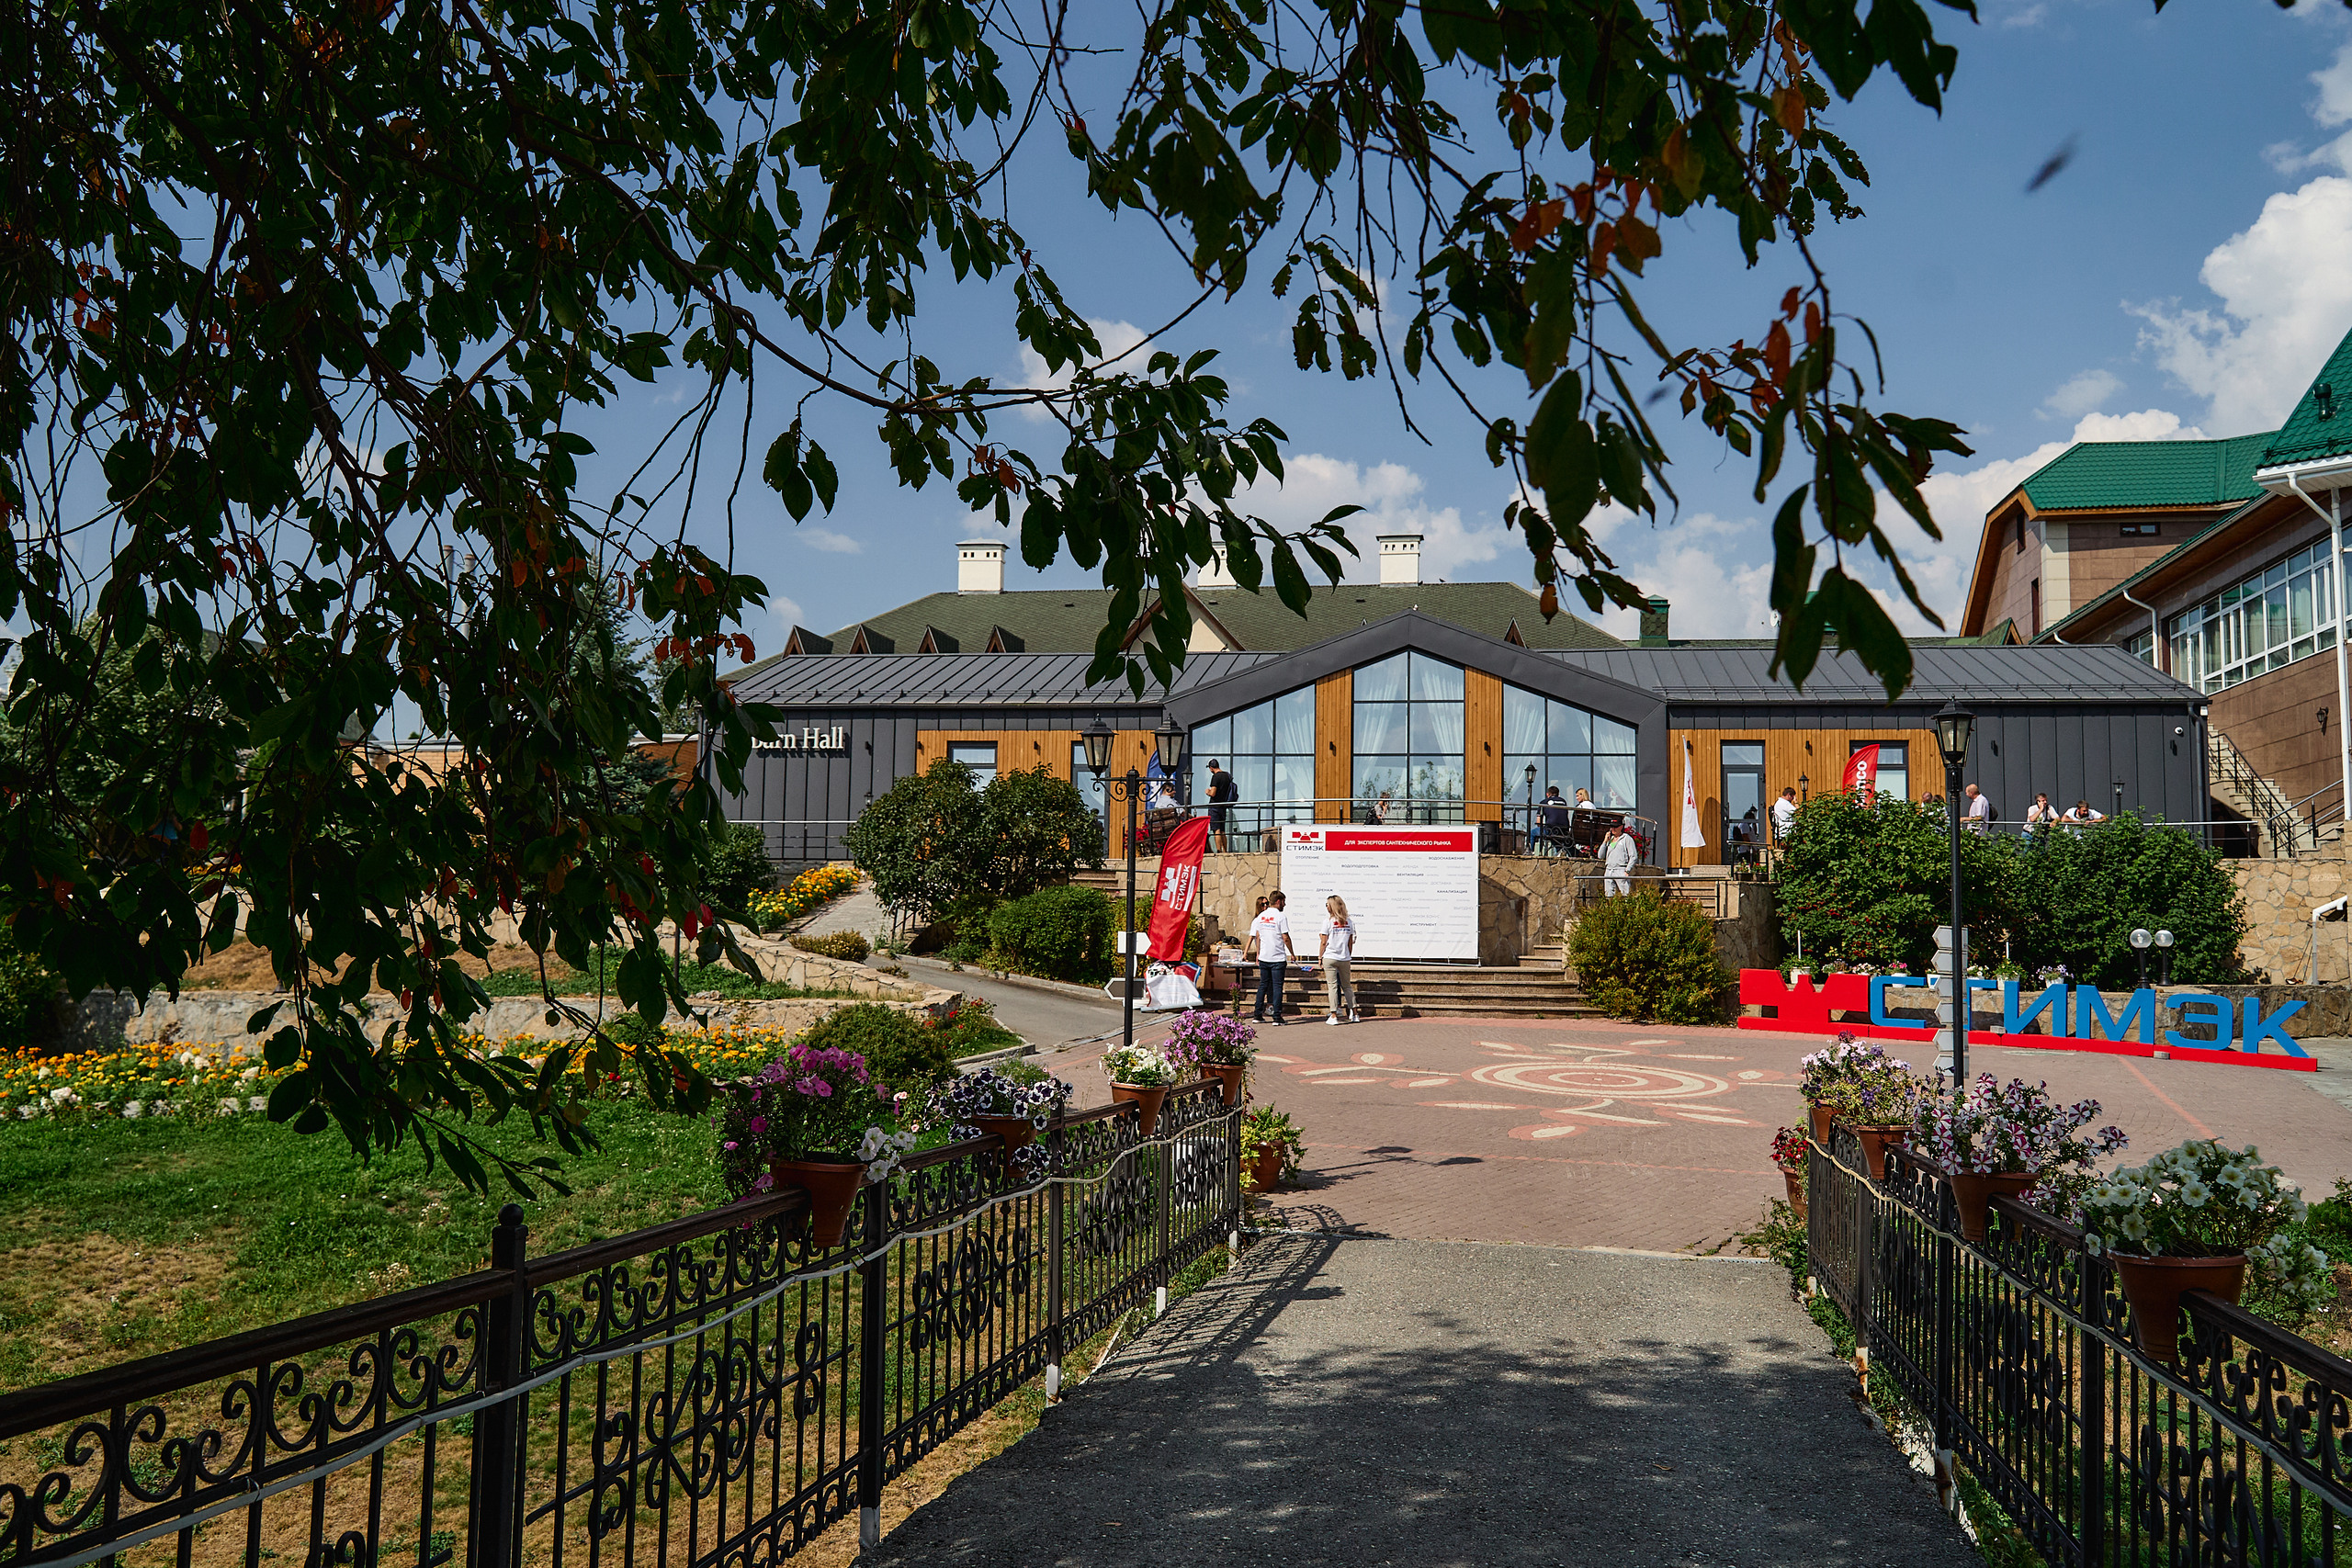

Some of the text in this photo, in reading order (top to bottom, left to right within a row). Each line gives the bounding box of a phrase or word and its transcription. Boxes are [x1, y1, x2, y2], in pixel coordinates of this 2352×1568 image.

[802, 726, 844, 750] Hall
[1174, 864, 1191, 911] СТИМЭК
[1870, 975, 2310, 1059] СТИМЭК
